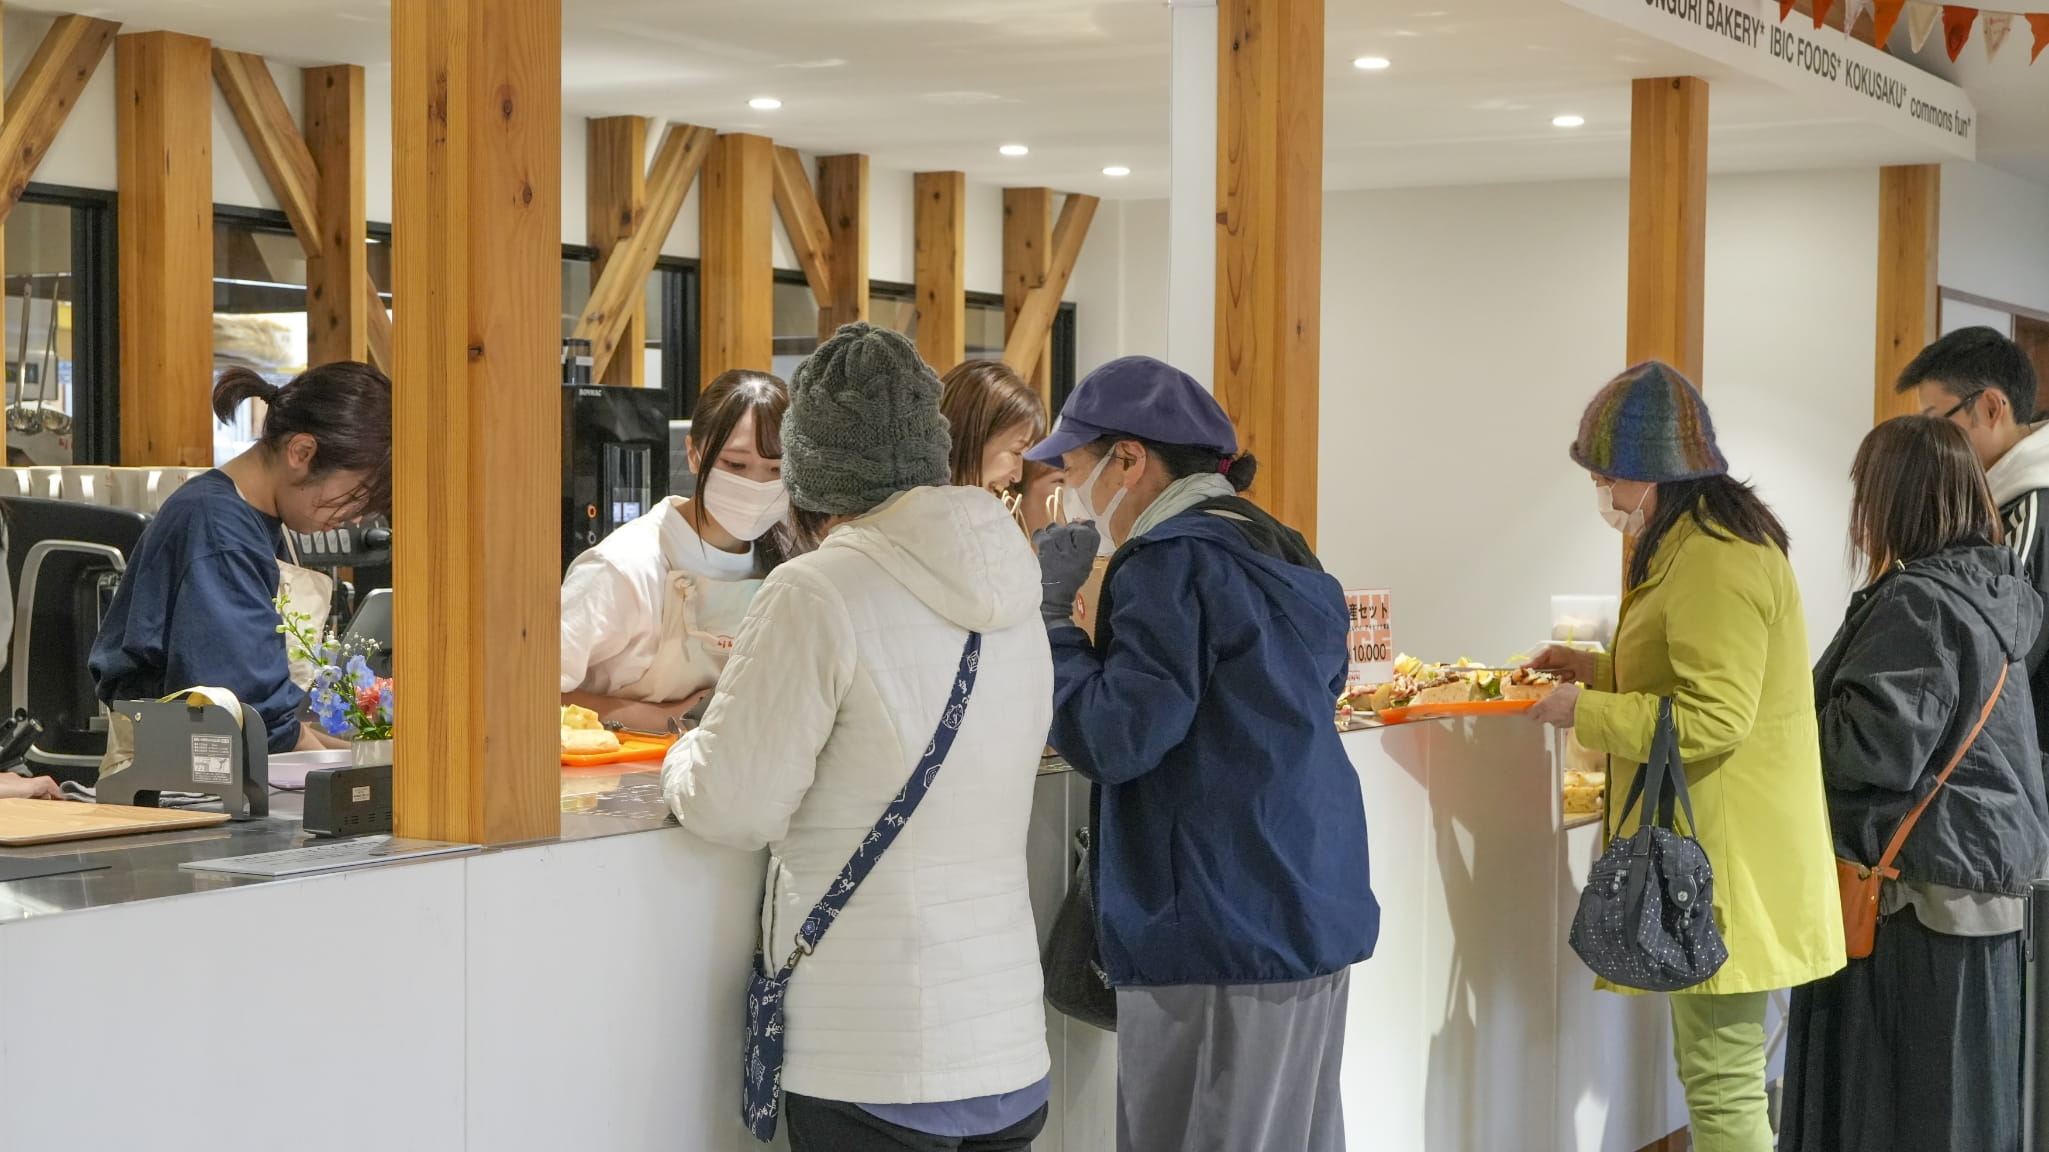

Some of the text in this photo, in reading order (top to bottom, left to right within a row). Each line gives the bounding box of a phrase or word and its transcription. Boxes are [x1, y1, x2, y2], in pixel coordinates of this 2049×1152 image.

[1645, 0, 1702, 26] GURI
[1770, 24, 1794, 64] IBIC
[1910, 97, 1953, 132] commons
